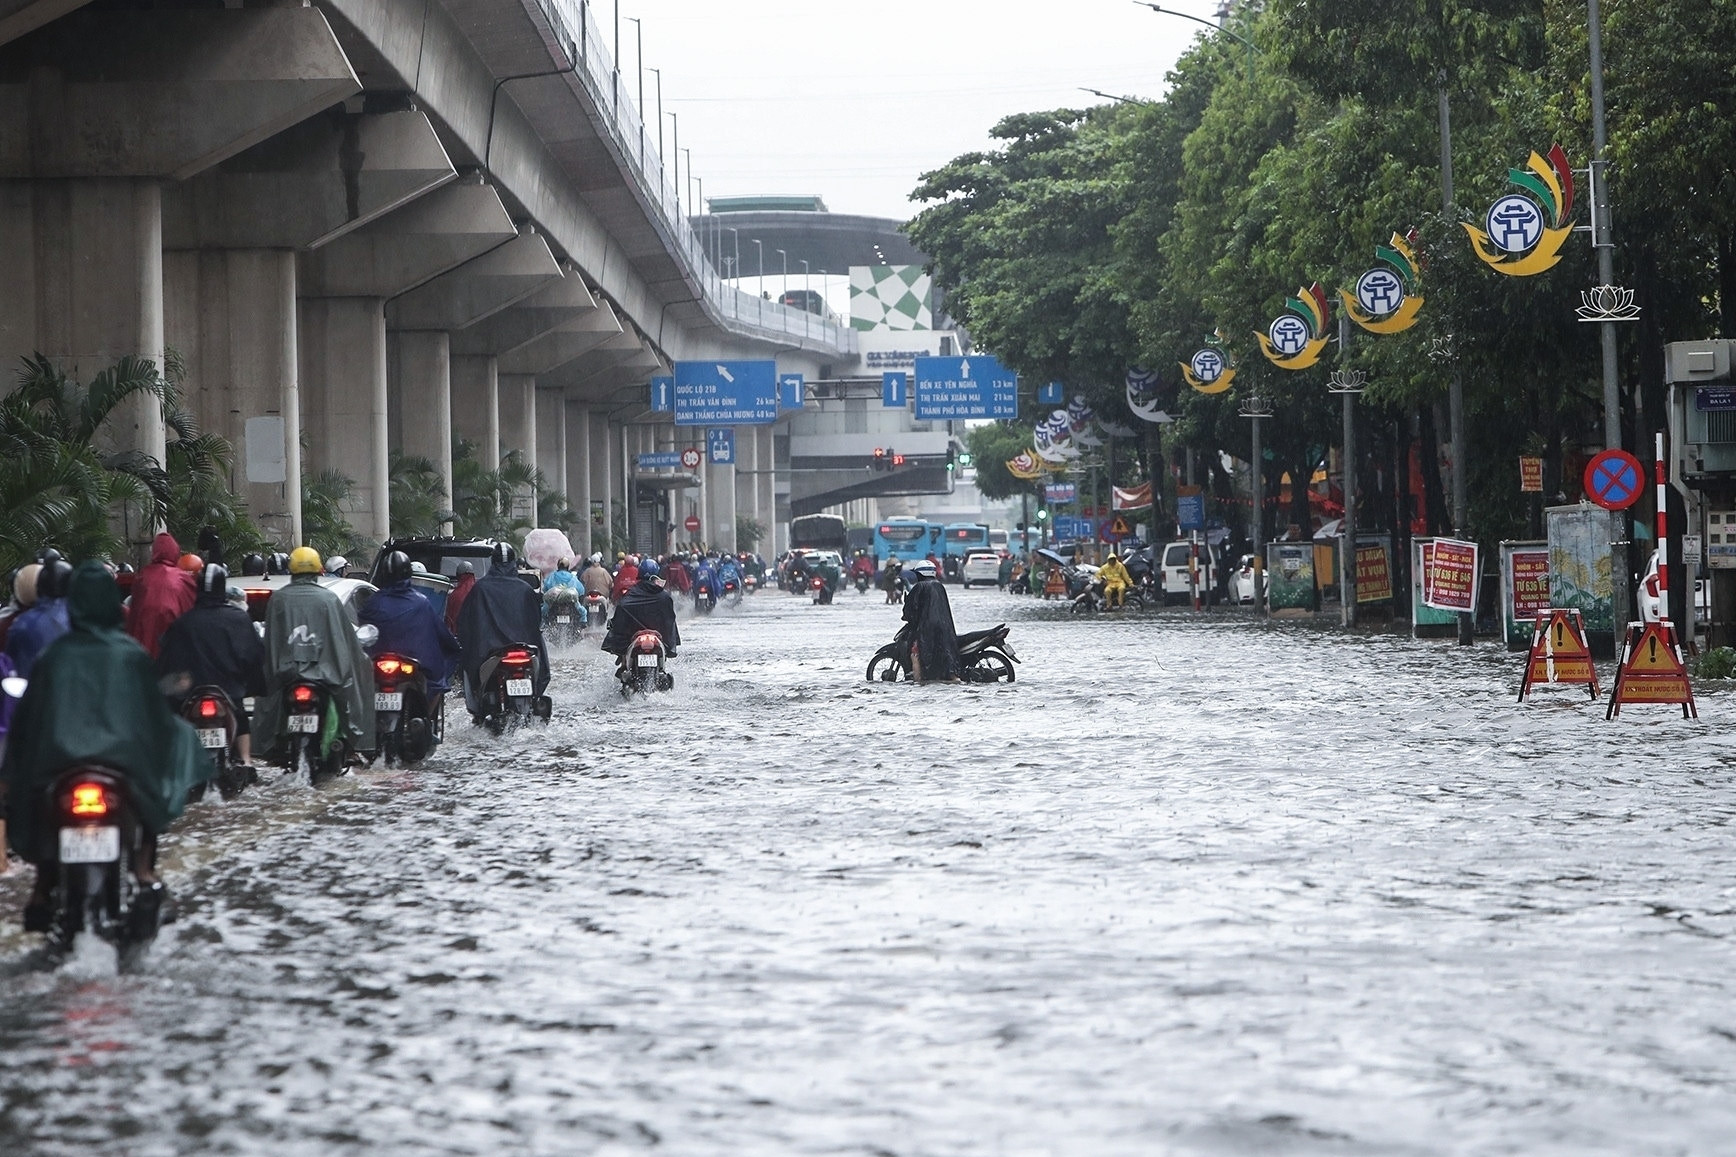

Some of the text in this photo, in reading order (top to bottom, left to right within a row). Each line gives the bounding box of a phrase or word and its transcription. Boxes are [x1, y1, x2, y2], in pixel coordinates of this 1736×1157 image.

[677, 384, 693, 393] QUỐC
[695, 385, 703, 394] LỘ
[934, 381, 942, 389] XE
[944, 380, 956, 389] YÊN
[677, 398, 687, 407] THỊ
[690, 396, 706, 406] TRẤN
[722, 396, 736, 405] ĐÌNH
[920, 394, 930, 404] THỊ
[932, 393, 949, 402] TRẤN
[951, 392, 967, 401] XUÂN
[921, 406, 940, 415] THÀNH
[942, 404, 955, 415] PHỐ
[971, 405, 985, 414] BÌNH
